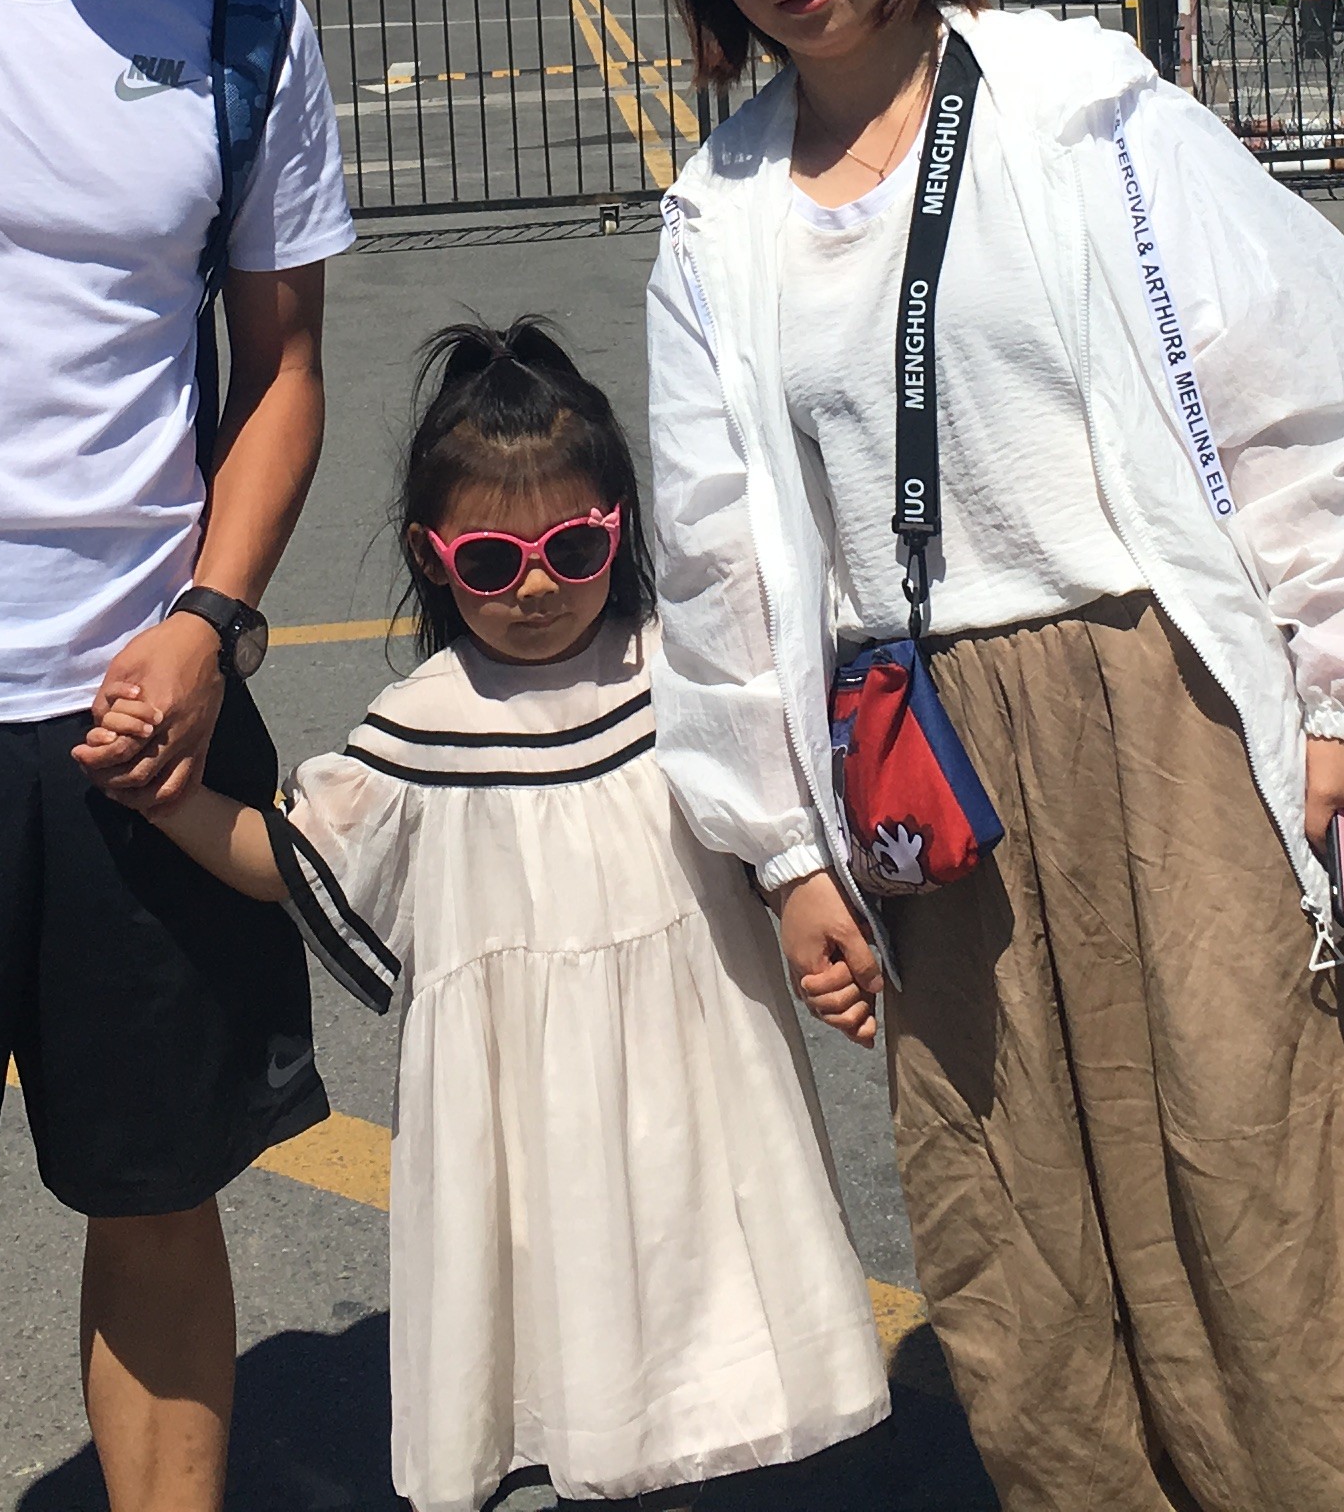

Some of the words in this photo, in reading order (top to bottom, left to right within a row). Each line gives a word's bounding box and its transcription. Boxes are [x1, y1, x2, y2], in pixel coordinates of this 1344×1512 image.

[127, 54, 186, 87] RUN
[921, 94, 964, 215] MENGHUO
[904, 279, 929, 410] MENGHUO
